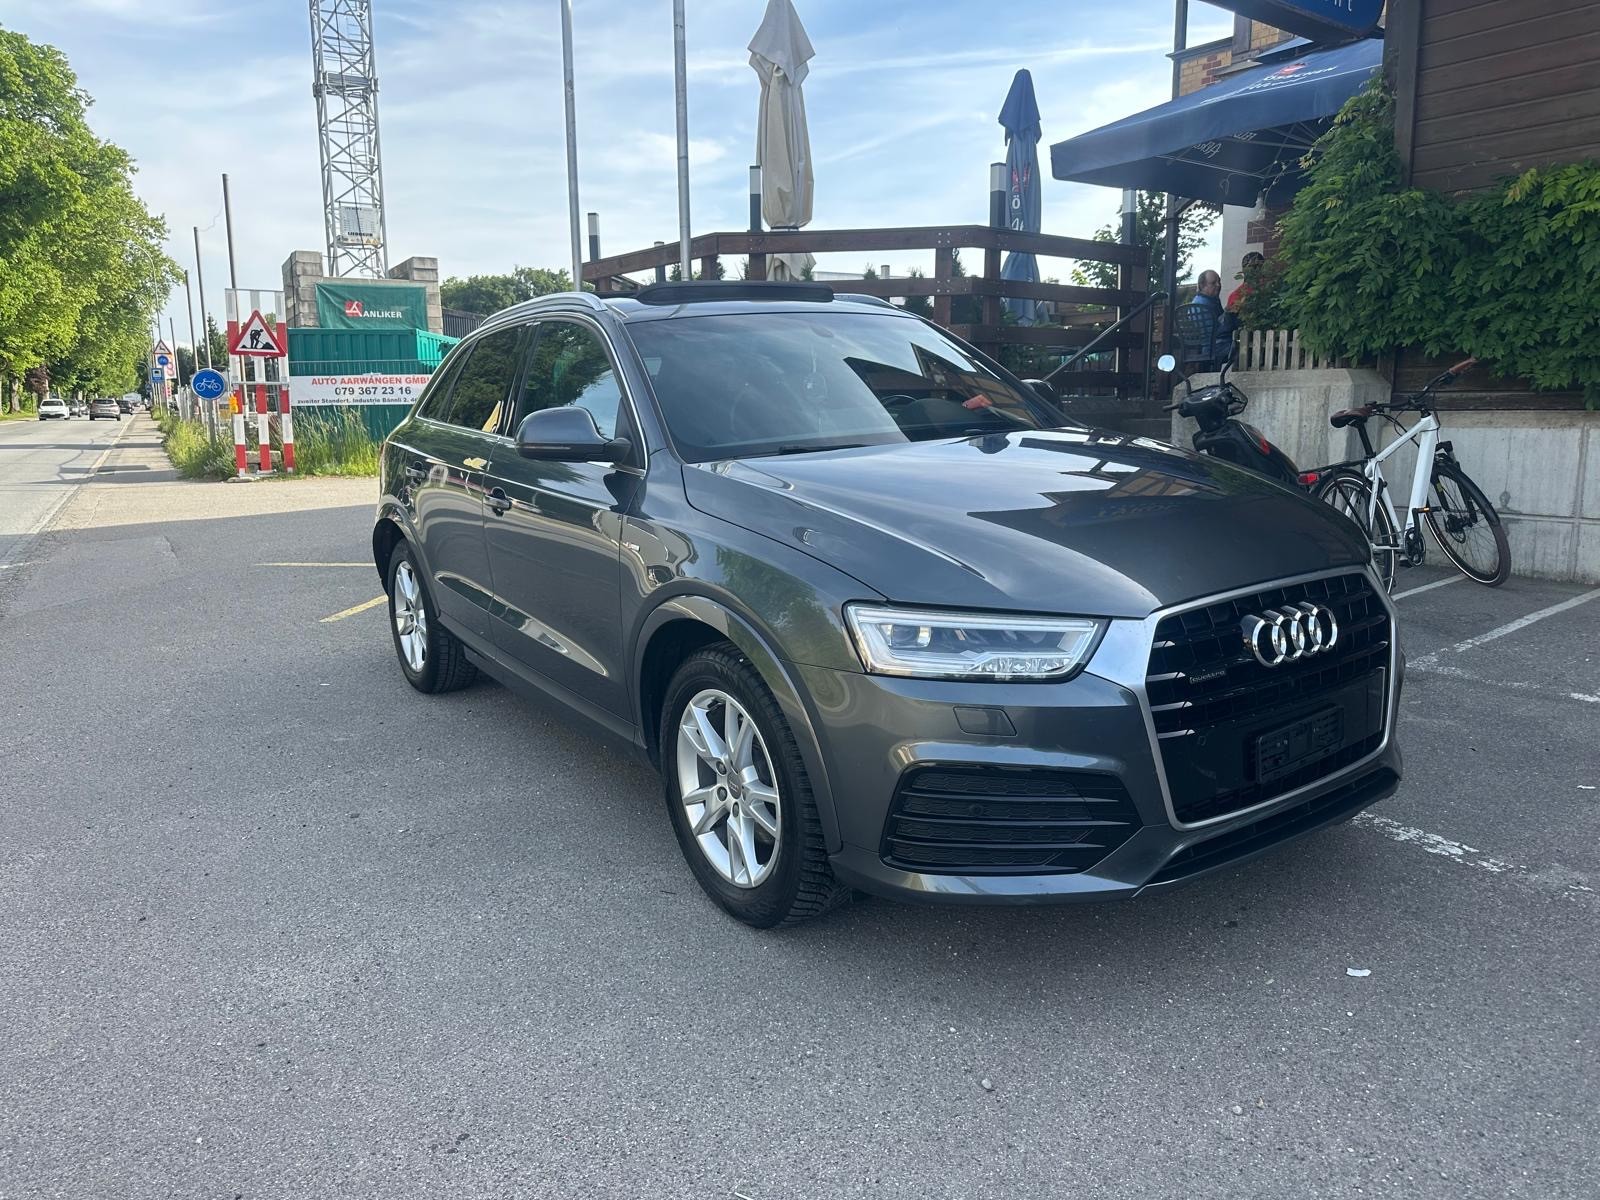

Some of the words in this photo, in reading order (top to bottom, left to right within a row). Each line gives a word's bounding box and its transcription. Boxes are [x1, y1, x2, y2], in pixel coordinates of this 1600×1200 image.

[363, 310, 402, 318] ANLIKER
[311, 377, 337, 385] AUTO
[340, 377, 402, 385] AARWANGEN
[334, 387, 355, 396] 079
[358, 386, 378, 395] 367
[381, 386, 394, 395] 23
[398, 386, 412, 395] 16
